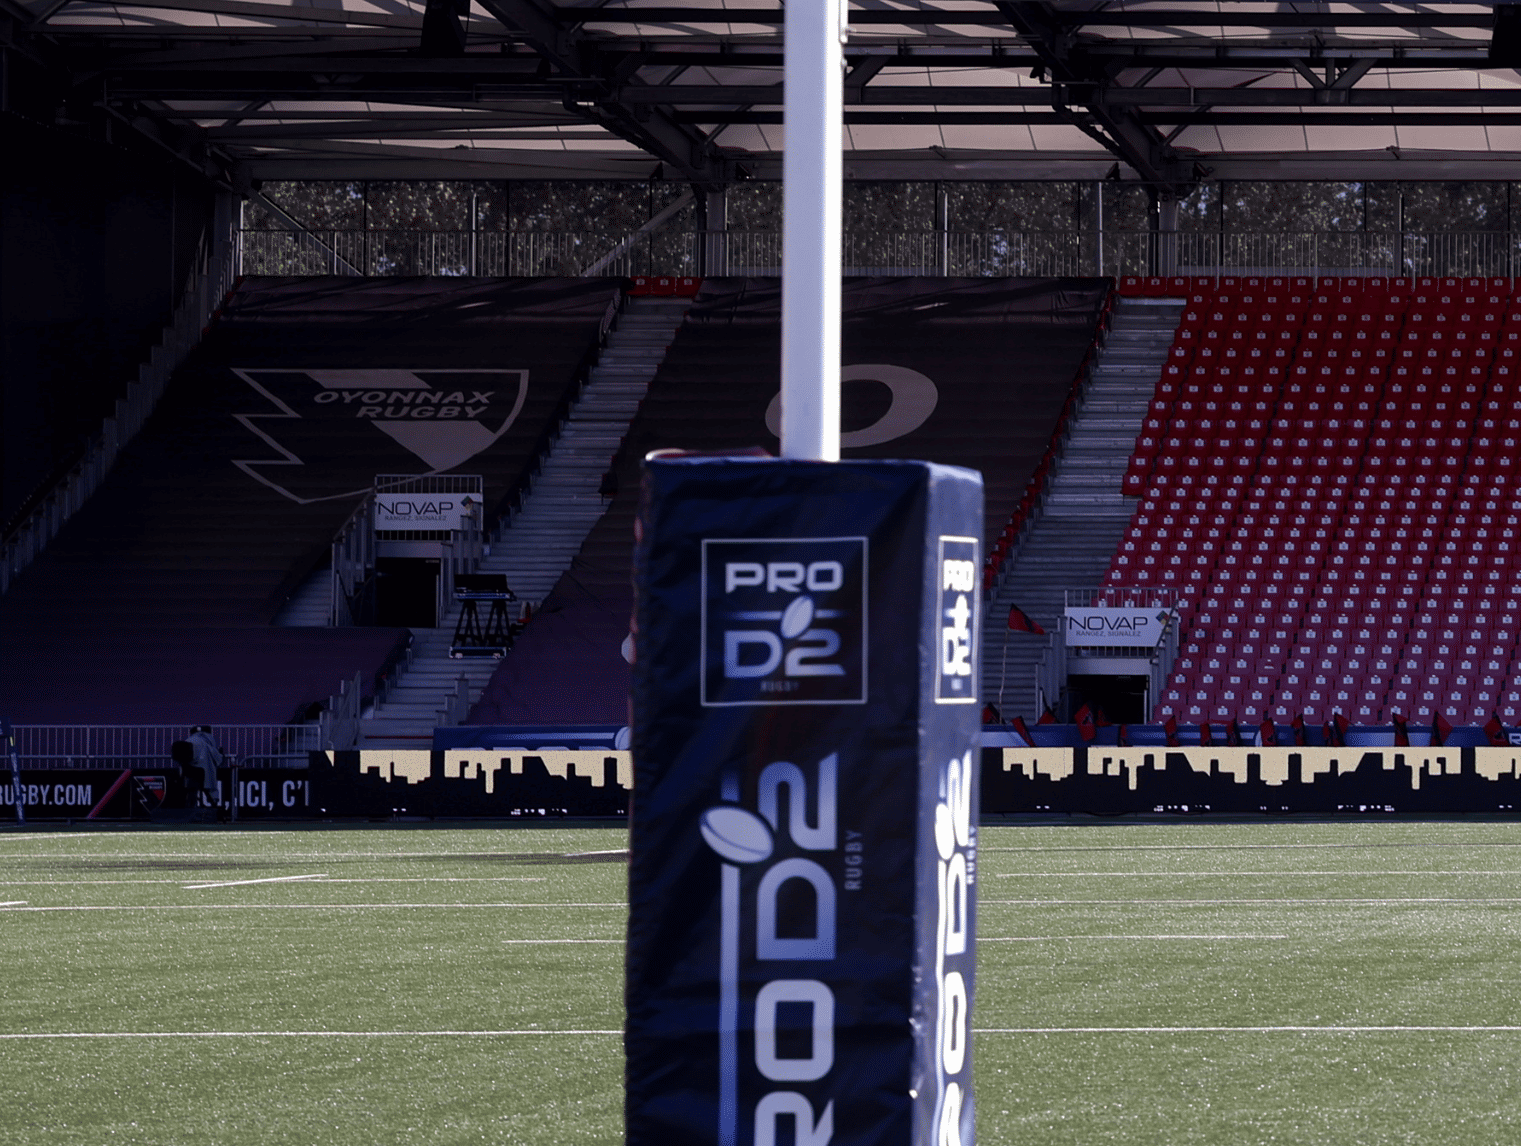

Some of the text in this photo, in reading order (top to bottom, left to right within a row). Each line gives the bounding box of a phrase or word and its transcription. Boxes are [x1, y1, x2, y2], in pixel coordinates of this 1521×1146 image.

[313, 390, 496, 404] OYONNAX
[355, 405, 488, 419] RUGBY
[378, 501, 454, 515] NOVAP
[724, 560, 845, 594] PRO
[1069, 616, 1148, 630] NOVAP
[723, 628, 847, 679] D2
[844, 829, 864, 892] RUGBY
